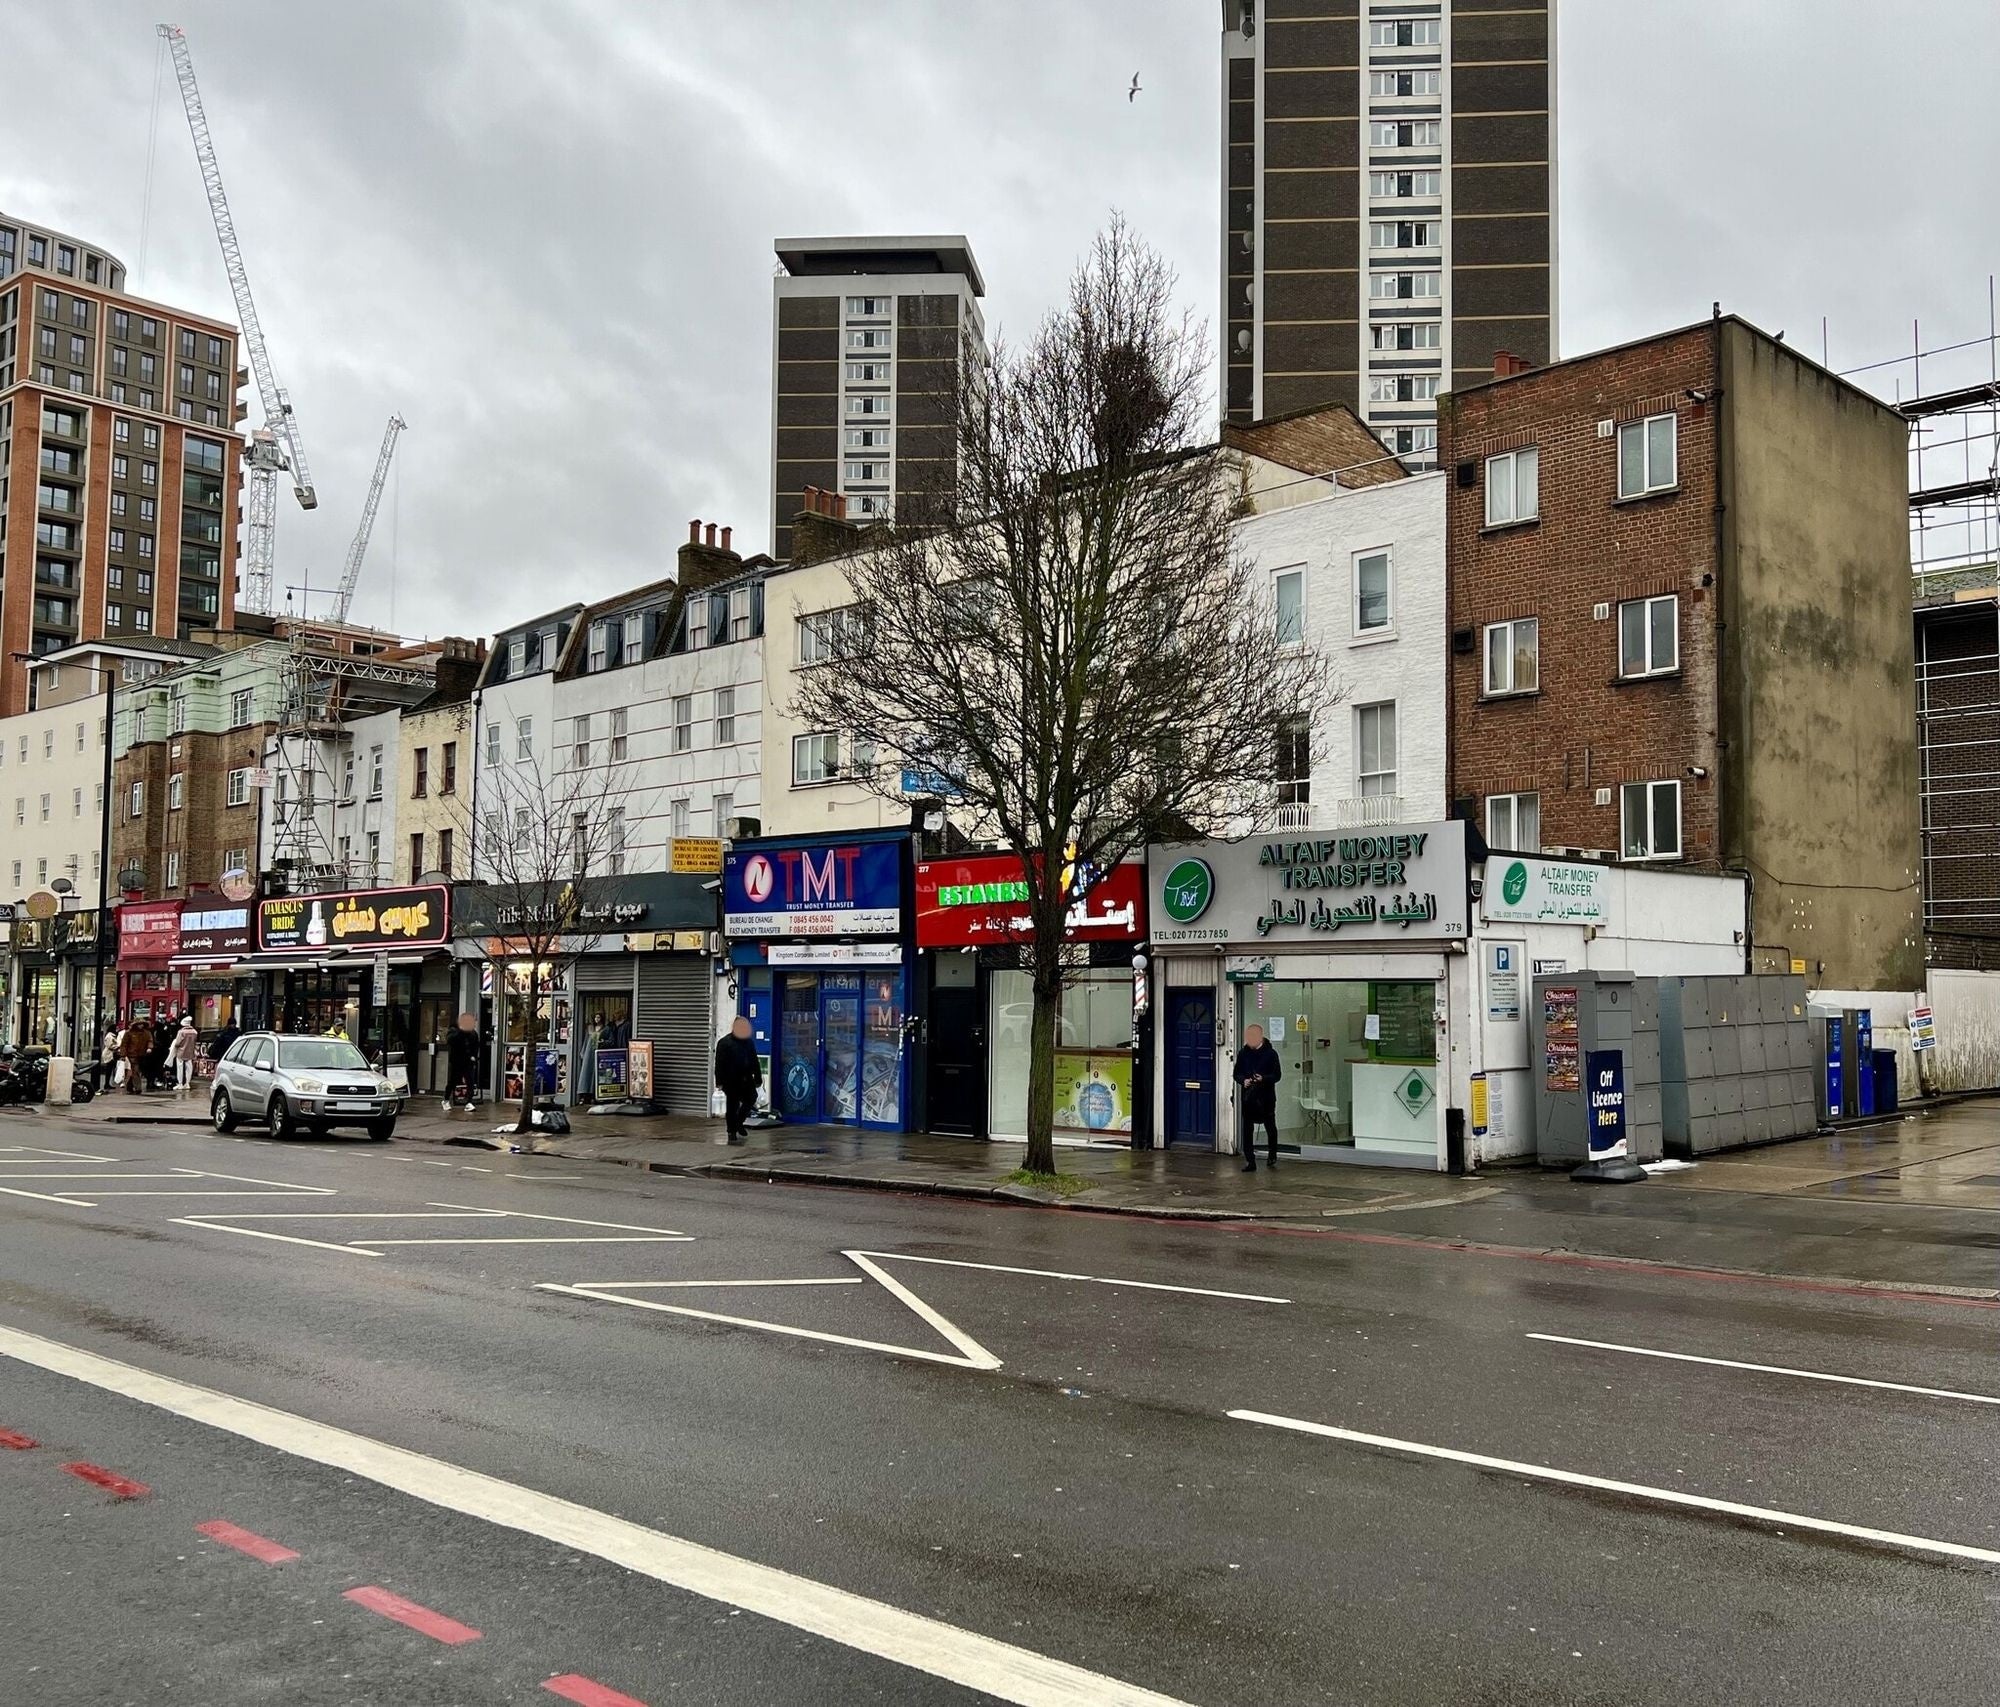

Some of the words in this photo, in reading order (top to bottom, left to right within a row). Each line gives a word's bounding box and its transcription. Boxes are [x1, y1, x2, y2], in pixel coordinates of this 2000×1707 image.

[1259, 840, 1335, 865] ALTAIF
[1340, 833, 1428, 860] MONEY
[727, 857, 736, 865] 375
[778, 848, 861, 902] TMT
[1280, 861, 1406, 888] TRANSFER
[1541, 867, 1568, 880] ALTAIF
[1571, 869, 1599, 883] MONEY
[938, 881, 1032, 906] ESTANBU
[1548, 882, 1592, 897] TRANSFER
[264, 900, 304, 915] DAMASCUS
[786, 903, 803, 911] TRUST
[804, 902, 824, 910] MONEY
[825, 901, 854, 909] TRANSFER
[1309, 896, 1377, 931] للتحويل
[1380, 892, 1437, 928] الطيف
[272, 916, 295, 930] BRIDE
[729, 916, 747, 924] BUREAU
[755, 915, 773, 923] CHANGE
[793, 915, 808, 923] 0845
[808, 915, 819, 923] 456
[820, 914, 834, 923] 0042
[758, 926, 781, 934] TRANSFER
[793, 925, 807, 933] 0845
[808, 925, 819, 933] 456
[819, 925, 834, 933] 0043
[1188, 930, 1207, 939] 7723
[1209, 929, 1229, 939] 7850
[1445, 923, 1462, 932] 379
[1499, 950, 1507, 968] P
[1545, 991, 1575, 1000] Christmas
[1548, 1043, 1577, 1052] Christmas
[1600, 1070, 1614, 1087] Off
[1592, 1091, 1622, 1107] Licence
[1598, 1109, 1617, 1126] Here
